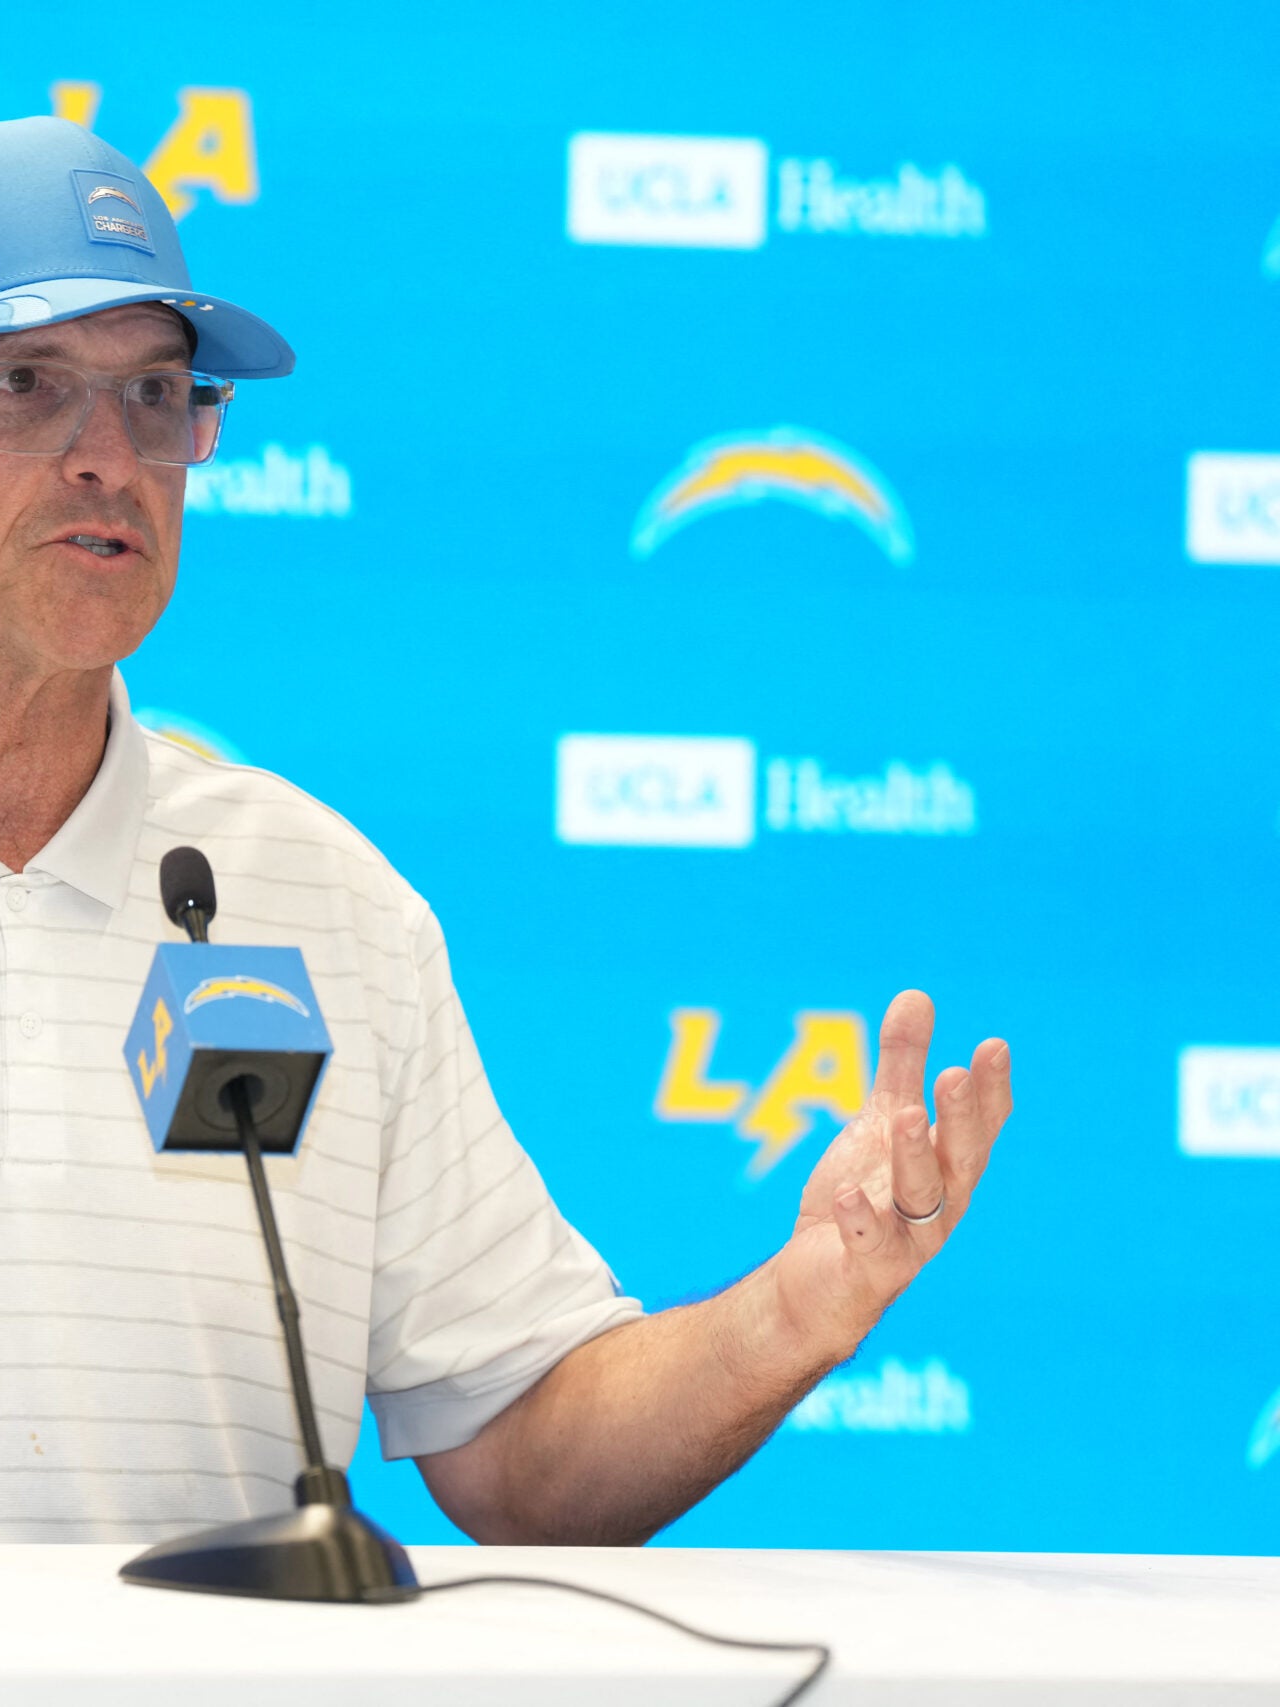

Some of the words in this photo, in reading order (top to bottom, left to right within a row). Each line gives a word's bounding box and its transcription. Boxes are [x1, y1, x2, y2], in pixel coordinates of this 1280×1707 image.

[95, 220, 148, 241] CHARGERS
[599, 165, 733, 215] UCLA
[776, 158, 987, 236] Health
[186, 440, 352, 517] ealth
[585, 765, 723, 815] UCLA
[765, 757, 976, 836] Health
[137, 997, 173, 1100] LA
[655, 1007, 870, 1178] LA
